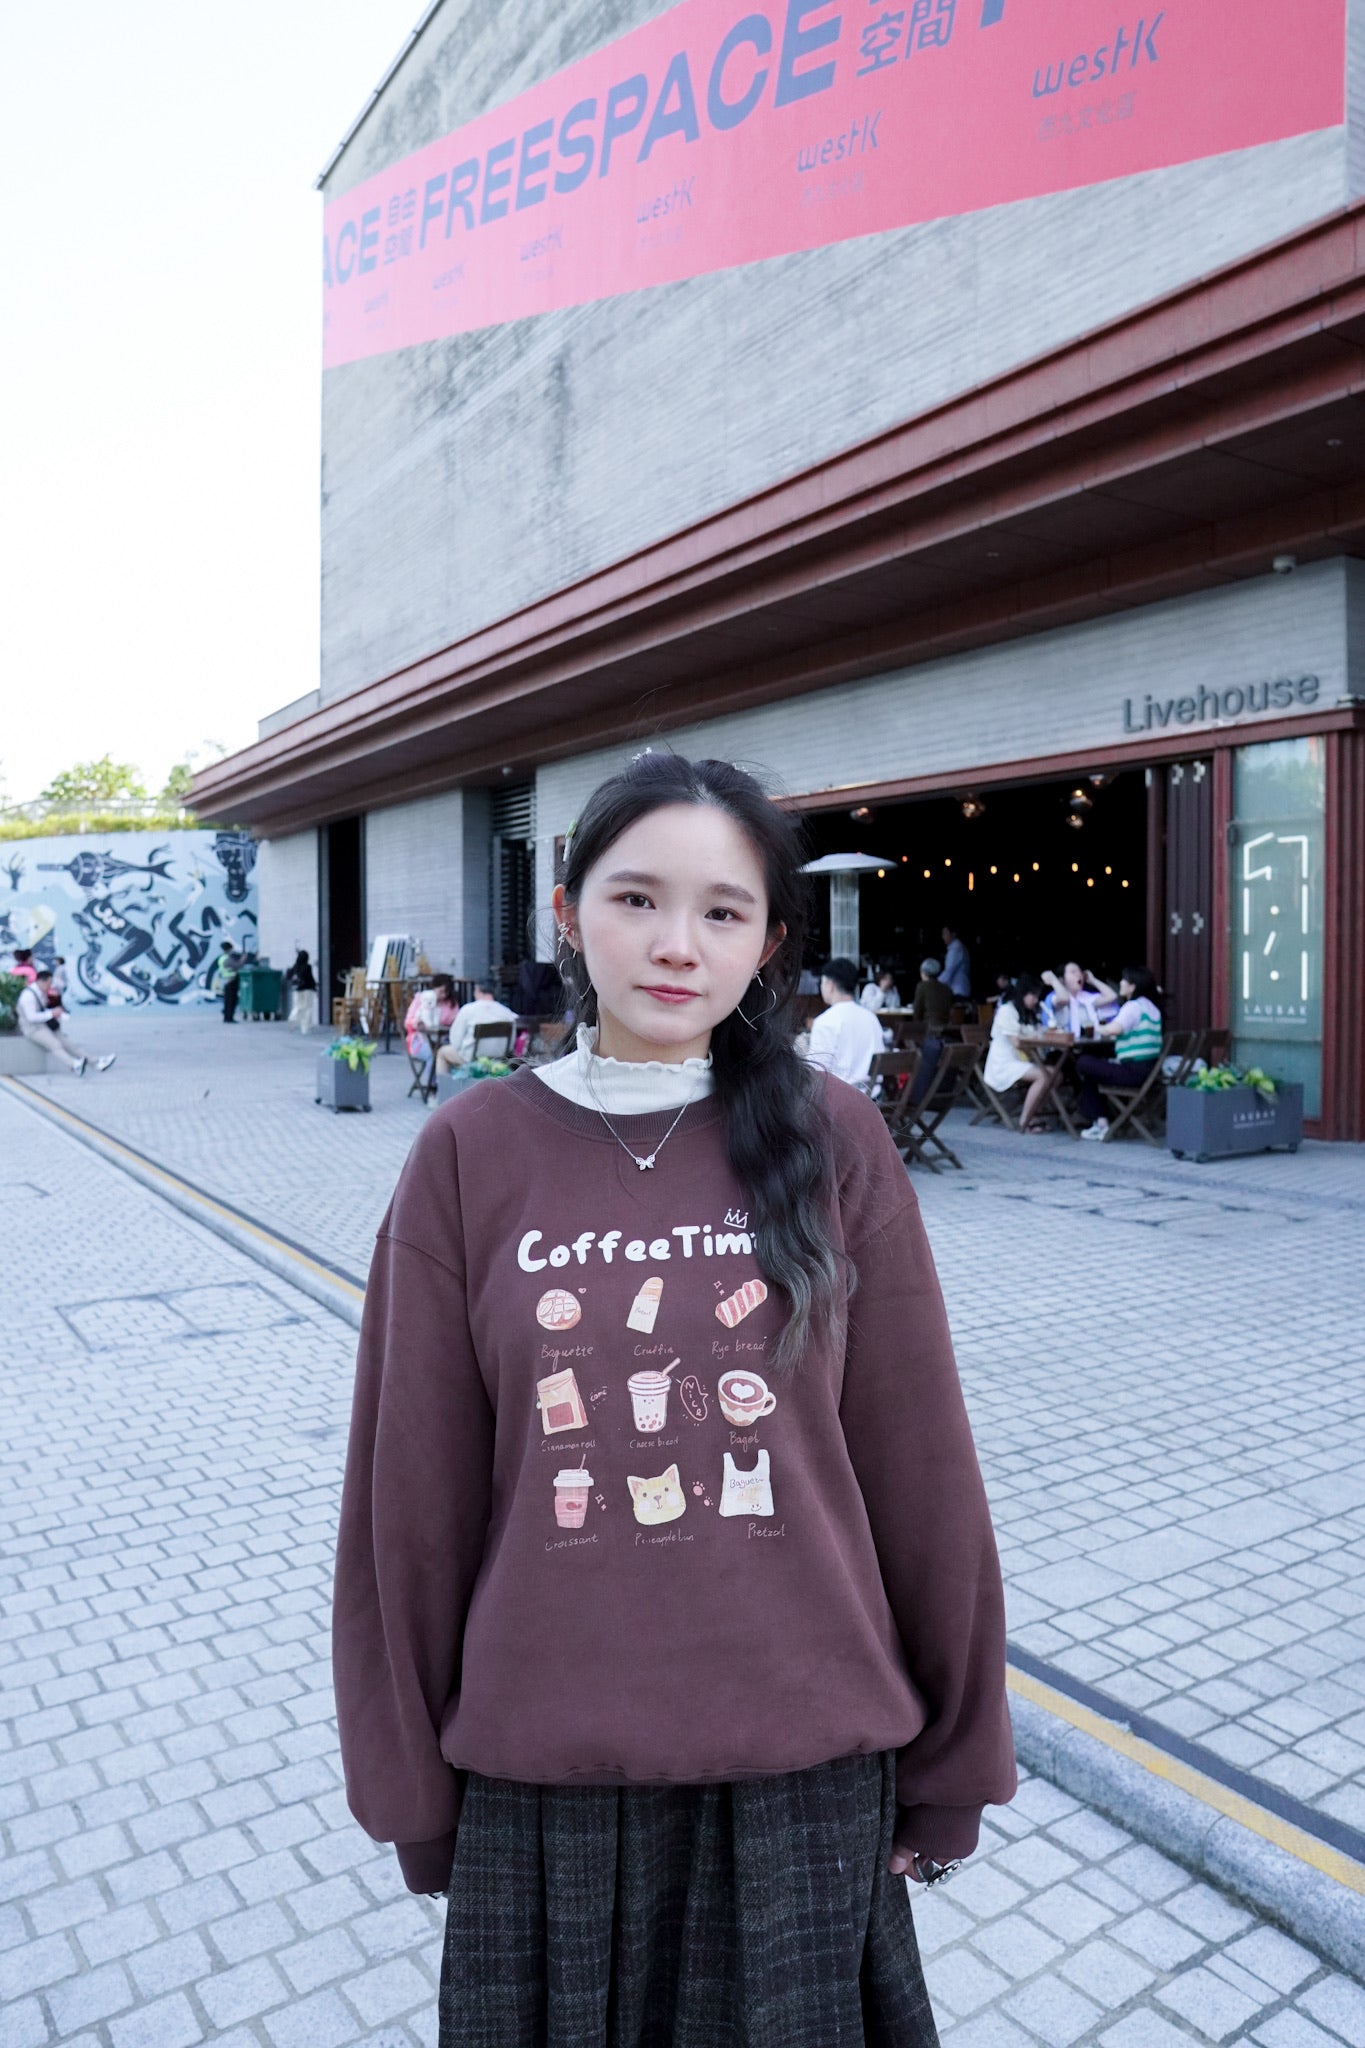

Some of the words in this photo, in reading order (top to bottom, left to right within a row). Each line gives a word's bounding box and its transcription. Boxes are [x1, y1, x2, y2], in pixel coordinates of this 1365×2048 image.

[856, 0, 956, 77] 空間
[1031, 10, 1166, 98] westK
[419, 0, 842, 249] FREESPACE
[797, 109, 882, 172] westK
[1123, 674, 1320, 734] Livehouse
[517, 1224, 758, 1273] CoffeeTim
[541, 1344, 594, 1373] Baguette
[712, 1340, 730, 1359] Rye
[735, 1339, 766, 1352] bread
